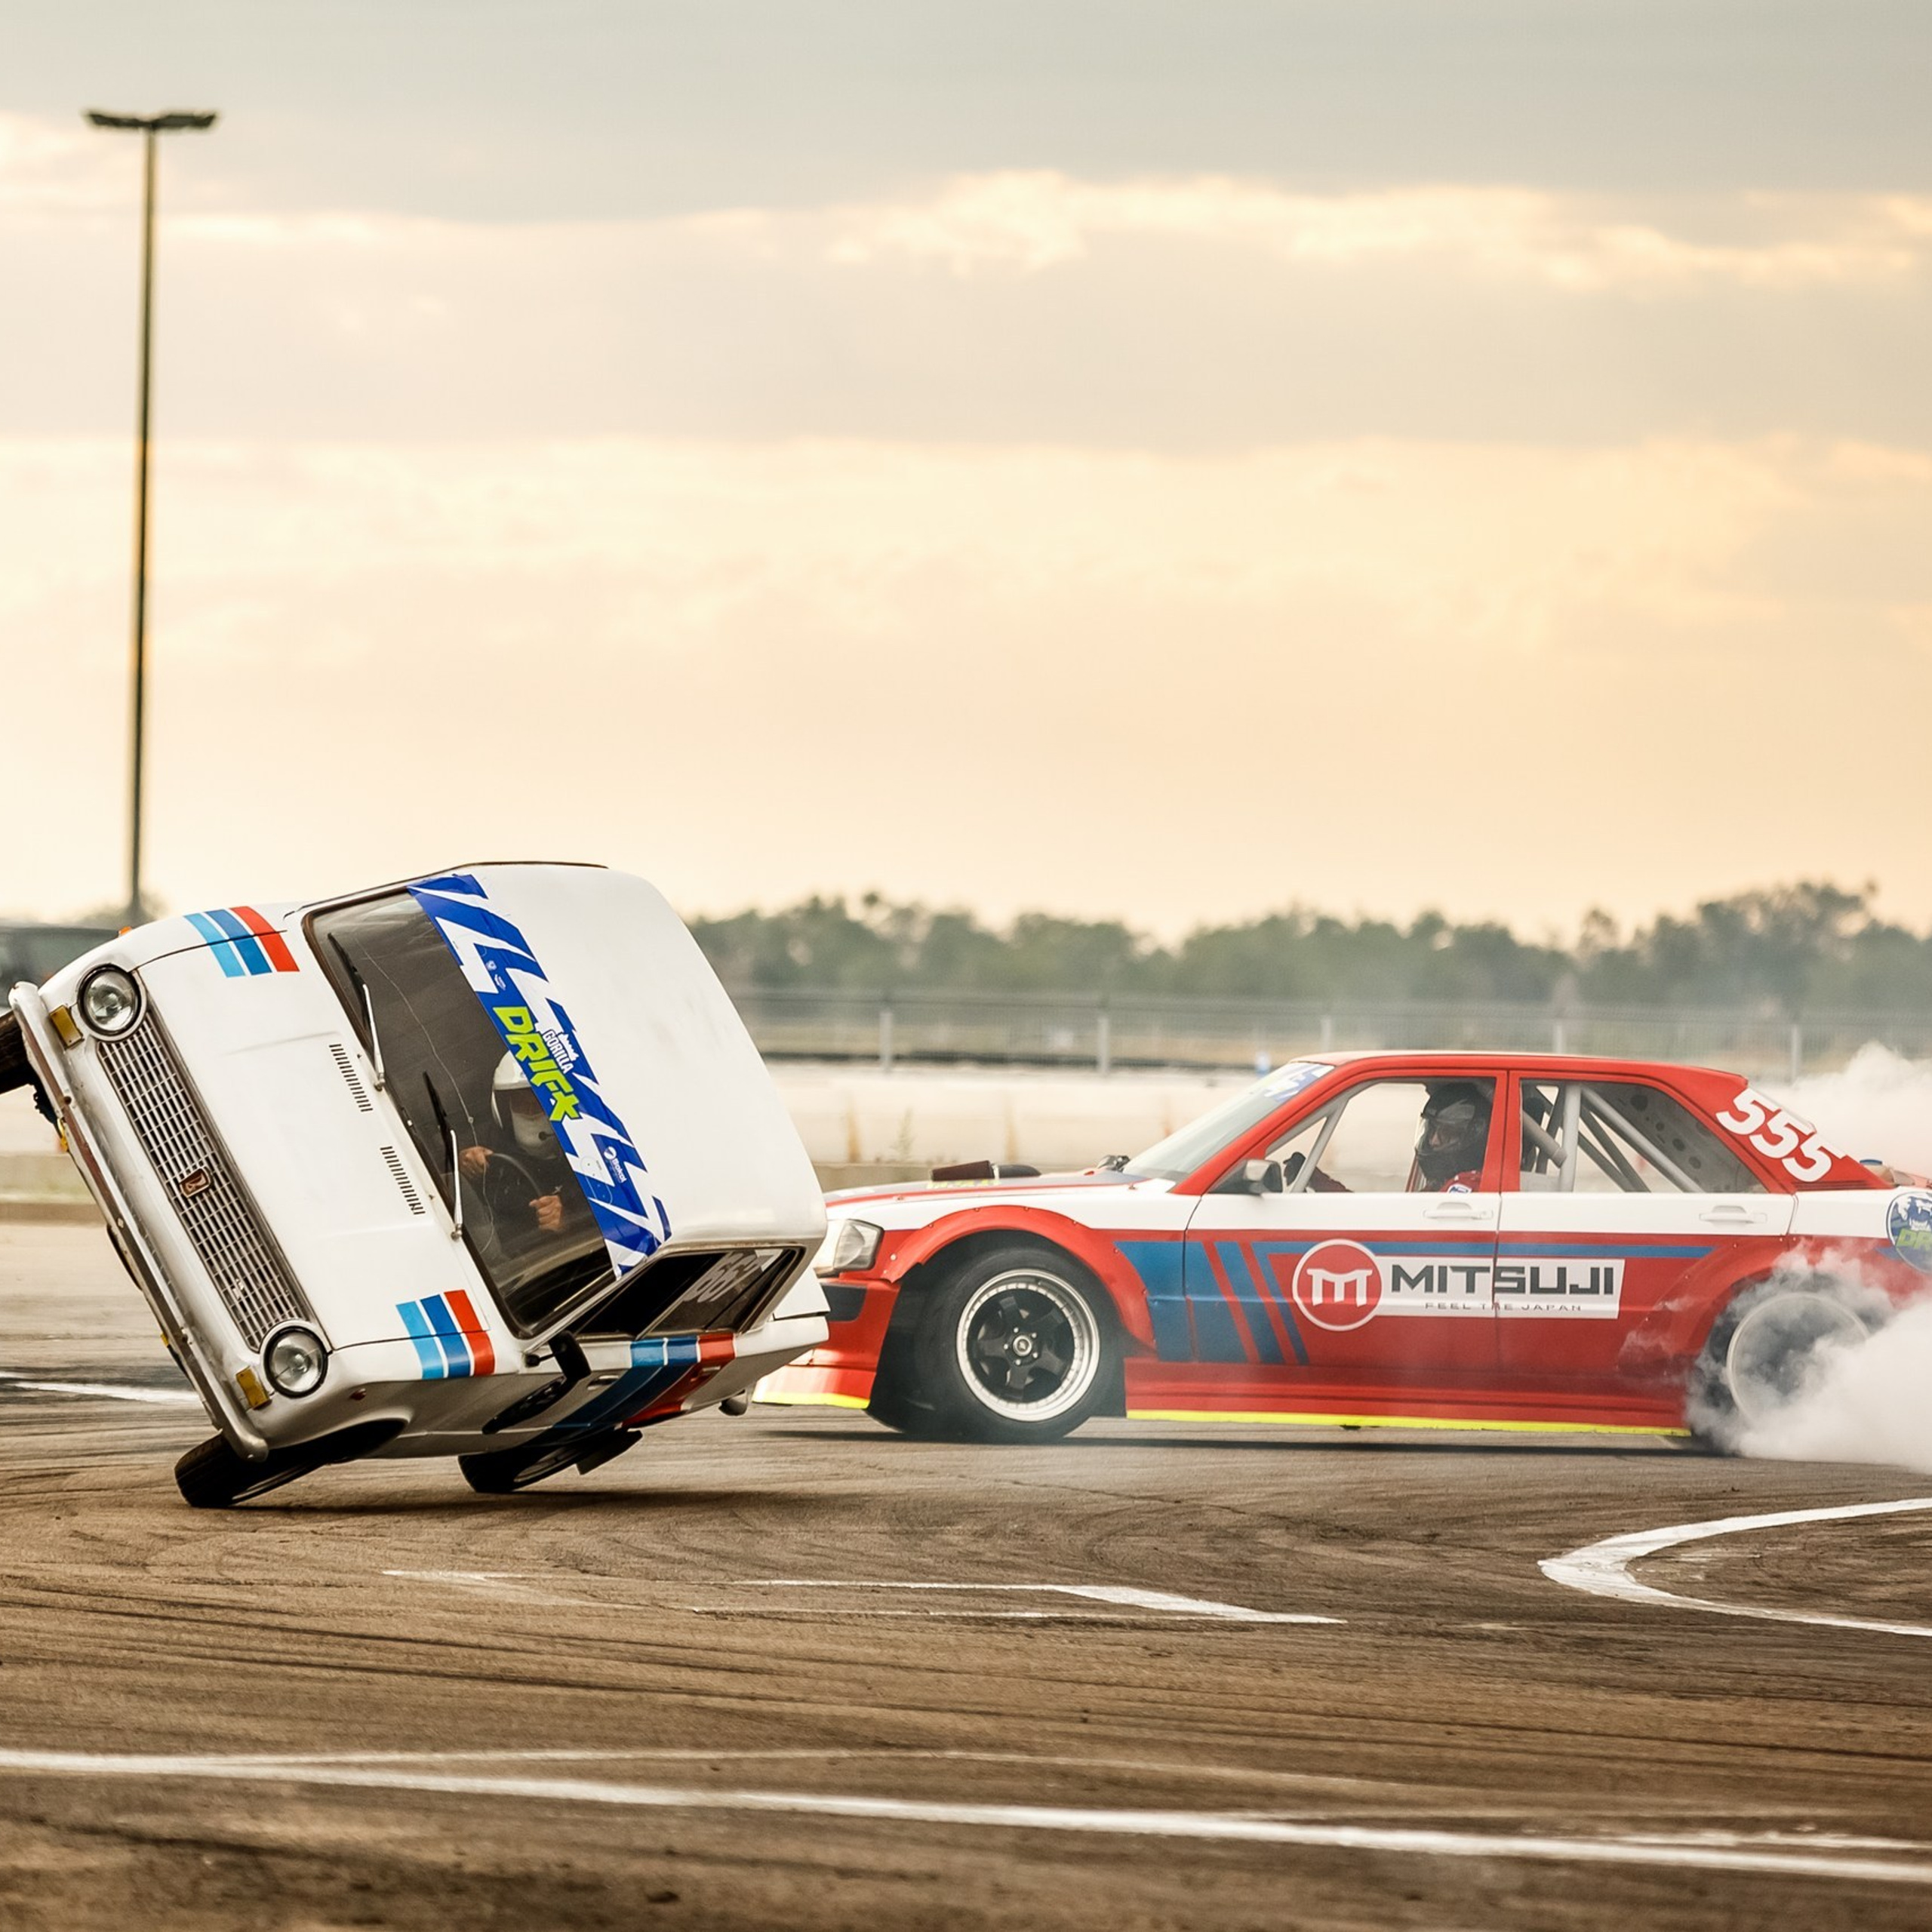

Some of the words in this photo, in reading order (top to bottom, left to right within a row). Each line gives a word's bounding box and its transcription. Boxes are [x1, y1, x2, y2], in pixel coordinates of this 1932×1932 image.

[493, 1007, 580, 1121] DRIFT
[543, 1030, 574, 1073] GORILLA
[1715, 1088, 1847, 1182] 555
[1392, 1264, 1614, 1295] MITSUJI
